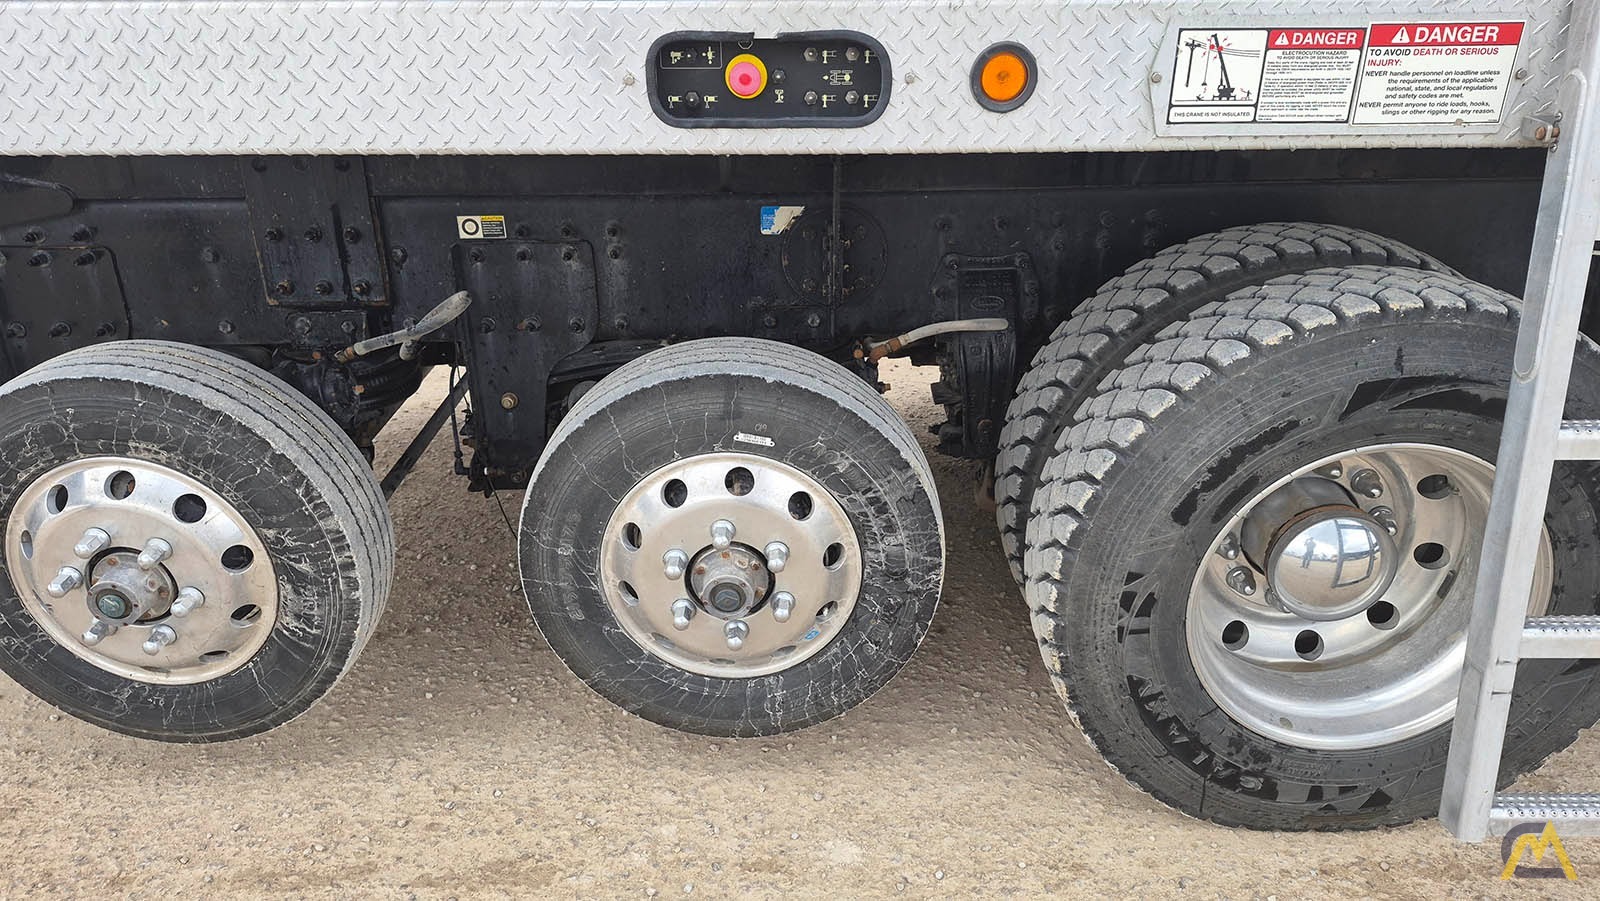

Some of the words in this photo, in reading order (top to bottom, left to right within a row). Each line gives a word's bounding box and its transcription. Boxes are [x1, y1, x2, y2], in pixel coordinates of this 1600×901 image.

[1292, 32, 1357, 45] DANGER
[1414, 26, 1500, 43] DANGER
[1370, 48, 1382, 56] TO
[1383, 48, 1411, 56] AVOID
[1413, 48, 1443, 56] DEATH
[1445, 48, 1458, 56] OR
[1460, 47, 1499, 55] SERIOUS
[1367, 59, 1402, 67] INJURY:
[1412, 70, 1443, 78] personnel
[1383, 101, 1404, 109] permit
